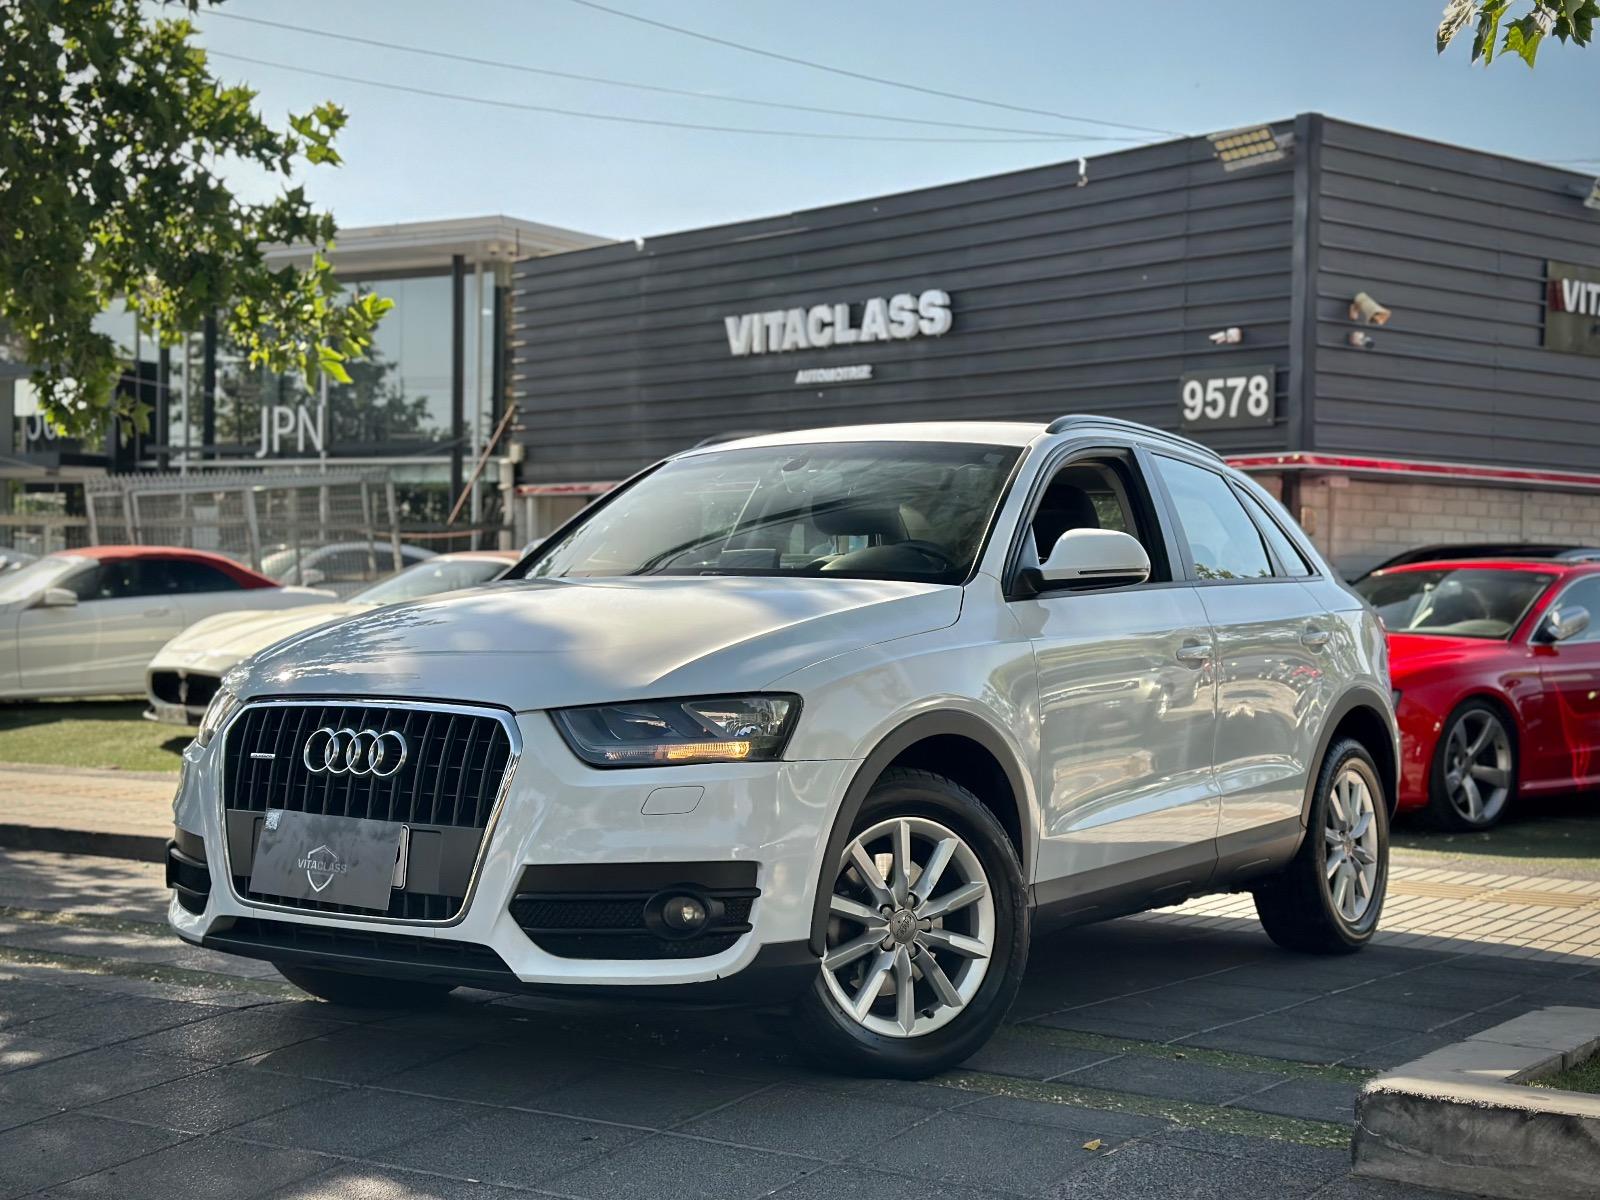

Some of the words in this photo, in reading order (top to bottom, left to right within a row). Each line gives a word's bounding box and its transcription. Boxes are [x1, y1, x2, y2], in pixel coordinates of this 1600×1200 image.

[725, 289, 952, 355] VITACLASS
[1183, 375, 1268, 421] 9578
[256, 405, 323, 458] JPN
[297, 858, 347, 873] VITACLASS
